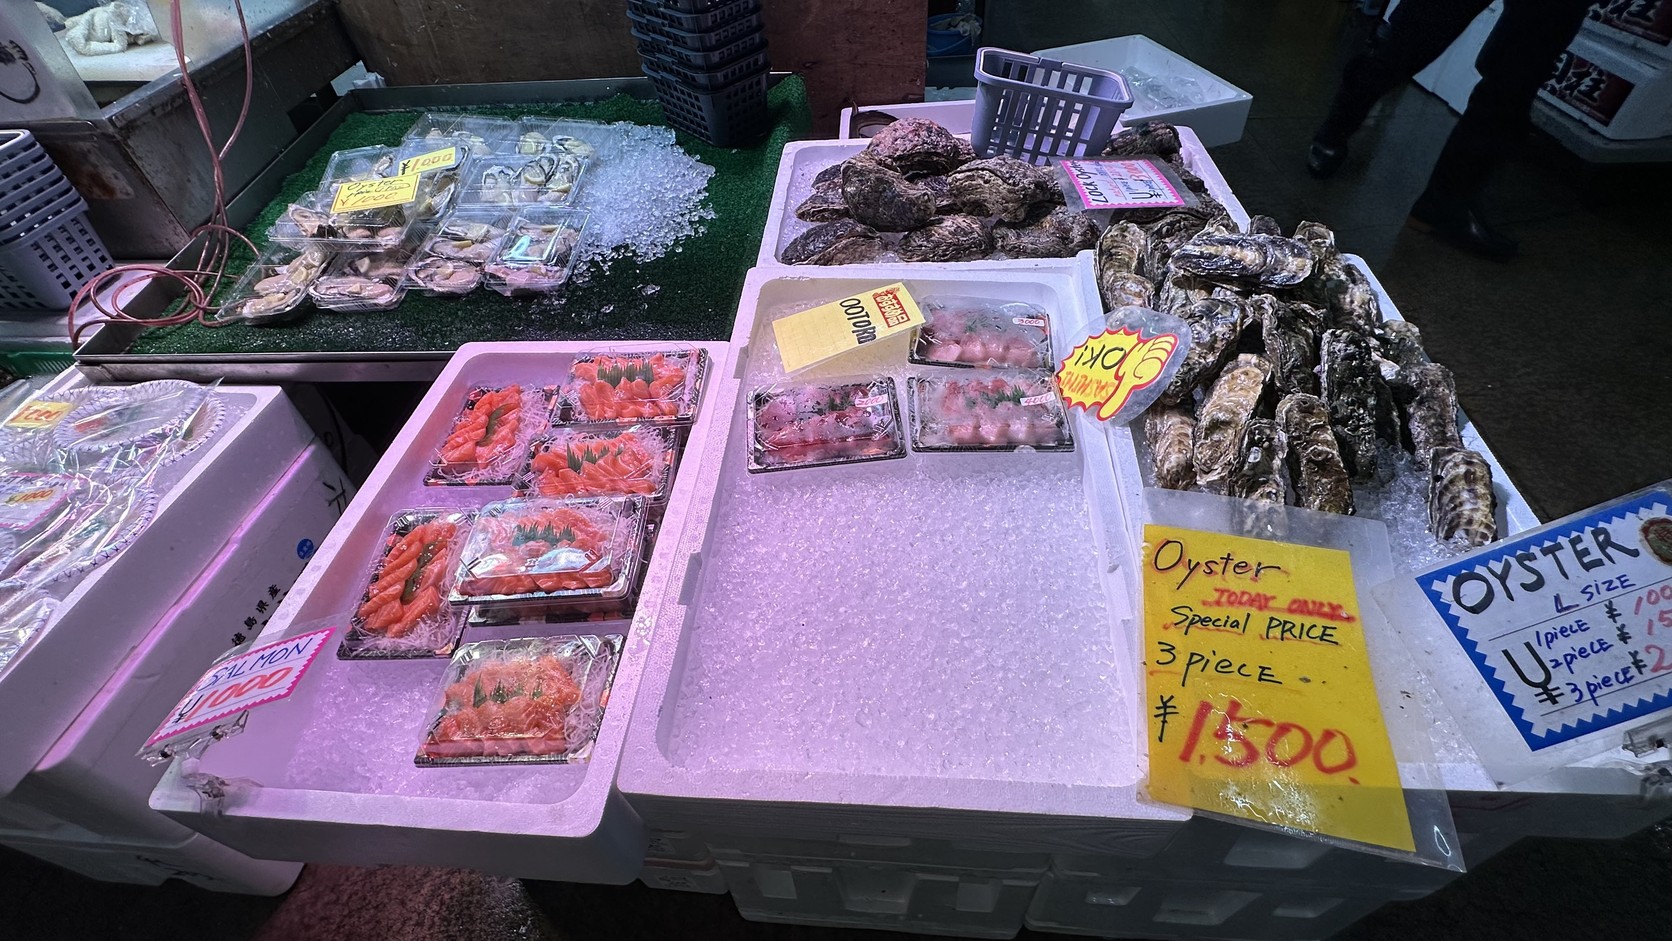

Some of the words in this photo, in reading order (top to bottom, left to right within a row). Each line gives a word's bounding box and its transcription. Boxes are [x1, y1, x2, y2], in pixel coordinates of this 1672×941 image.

[1083, 180, 1109, 203] LOCK
[1153, 539, 1283, 591] Oyster
[1452, 526, 1641, 615] OYSTER
[1212, 587, 1277, 612] TODAY
[1553, 593, 1579, 613] L
[1170, 605, 1251, 636] Special
[1265, 616, 1340, 646] PRICE
[197, 638, 314, 691] SALMON
